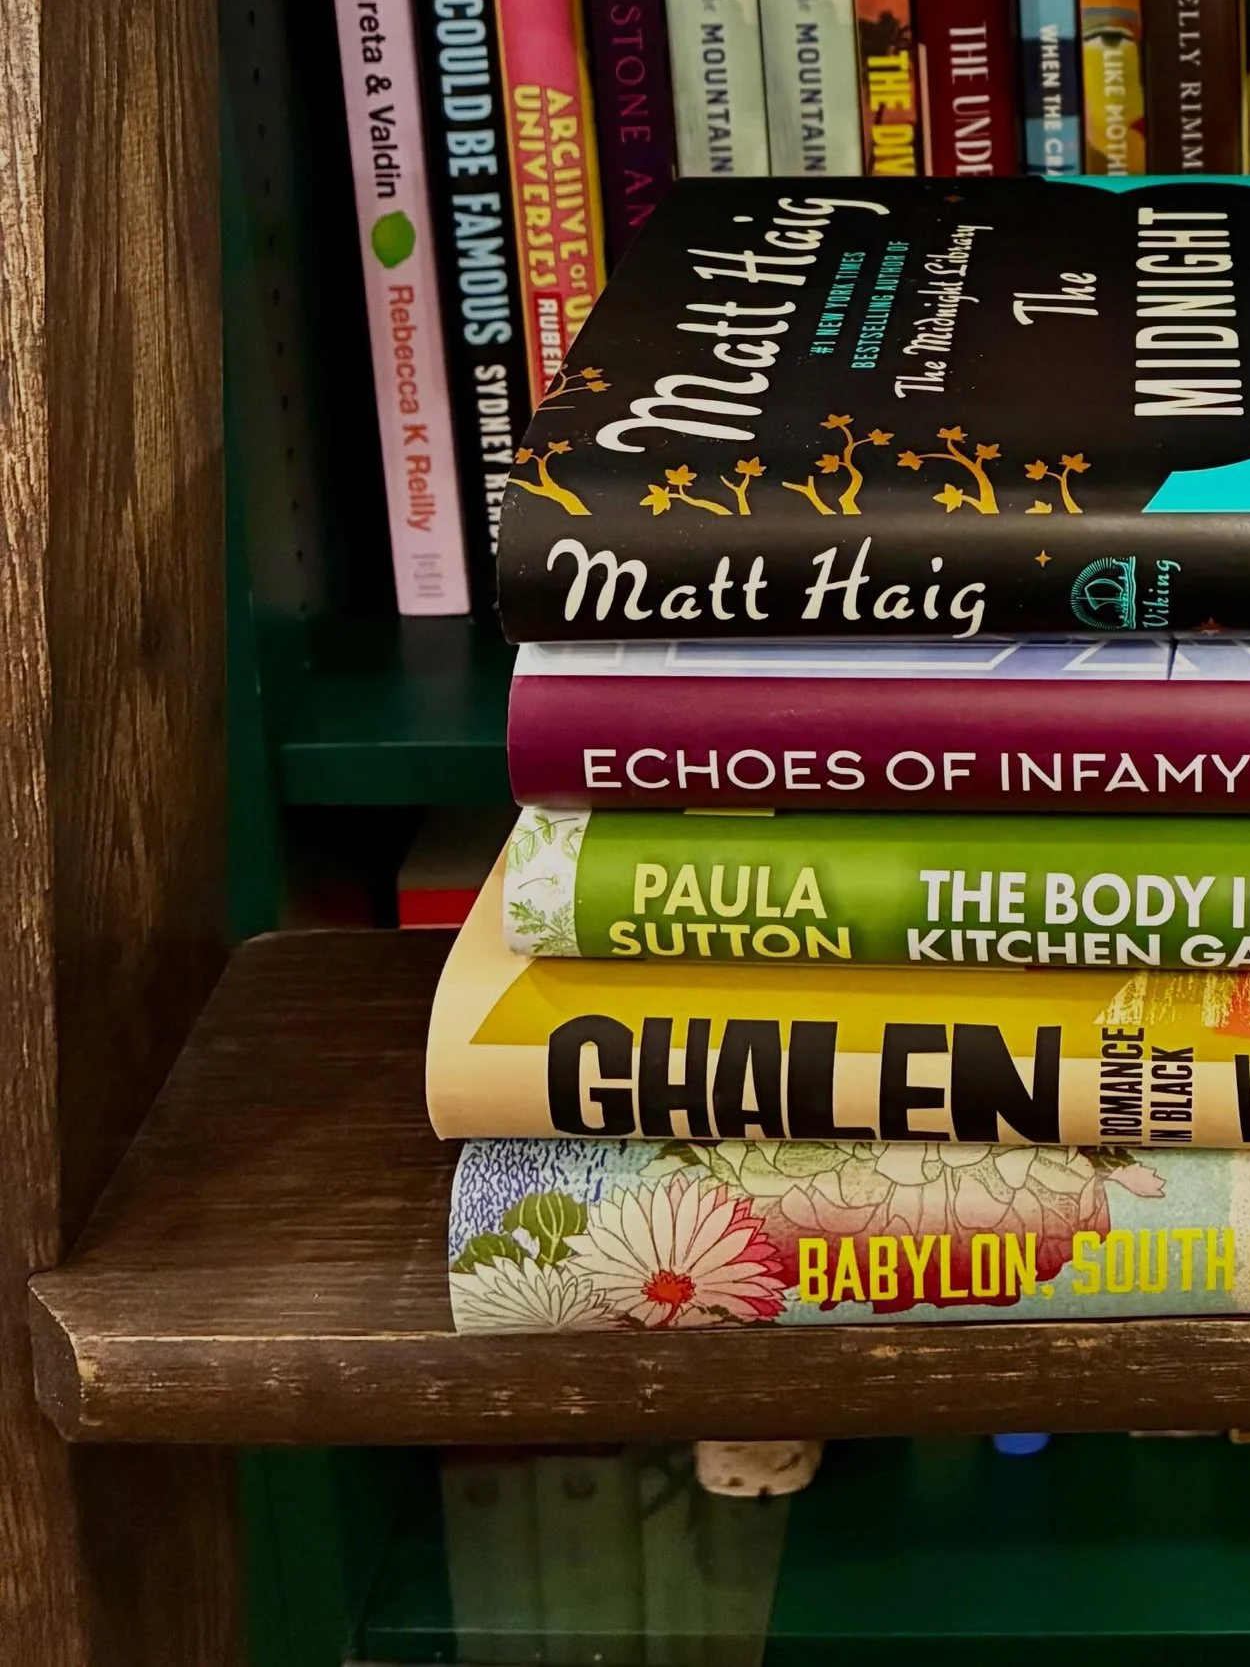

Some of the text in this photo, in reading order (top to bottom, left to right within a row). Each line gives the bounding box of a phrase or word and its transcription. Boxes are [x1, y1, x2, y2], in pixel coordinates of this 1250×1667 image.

[364, 74, 393, 96] &
[609, 2, 651, 144] STONE
[700, 23, 734, 174] MOUNTAIN
[795, 22, 827, 174] MOUNTAIN
[867, 50, 911, 112] THE
[948, 20, 989, 85] THE
[1039, 24, 1061, 88] WHEN
[1102, 48, 1126, 97] LIKE
[369, 104, 403, 200] Valdin
[445, 128, 500, 178] BE
[1042, 94, 1063, 132] THE
[1180, 81, 1204, 170] RIMM
[512, 84, 558, 289] UNIVERSES
[546, 86, 588, 262] ARCHIVE
[450, 192, 513, 347] FAMOUS
[809, 251, 867, 355] #1 NEW YORK TIMES
[850, 240, 911, 369] BESTSELLING AUTHOR OF
[894, 224, 995, 399] The Midnight Library
[1013, 271, 1099, 325] The
[1133, 206, 1245, 416] MIDNIGHT
[387, 284, 420, 415] Rebecca
[595, 197, 891, 454] Matt Haig
[402, 423, 430, 445] K
[474, 363, 514, 465] SYDNEY
[402, 455, 437, 533] Reilly
[545, 538, 769, 622] Matt
[800, 535, 988, 639] Haig
[1142, 557, 1182, 629] Viking
[583, 747, 866, 790] ECHOES
[885, 749, 977, 791] OF
[633, 862, 828, 920] PAULA
[919, 869, 1027, 925] THE
[1044, 872, 1217, 929] BODY
[608, 920, 852, 960] SUTTON
[906, 928, 1162, 967] KITCHEN
[546, 1013, 1062, 1145] GHALEN
[1099, 1027, 1145, 1136] ROMANCE
[1149, 1045, 1194, 1143] IN BLACK
[798, 1232, 1055, 1304] BABYLON,
[1070, 1227, 1236, 1296] SOUTH
